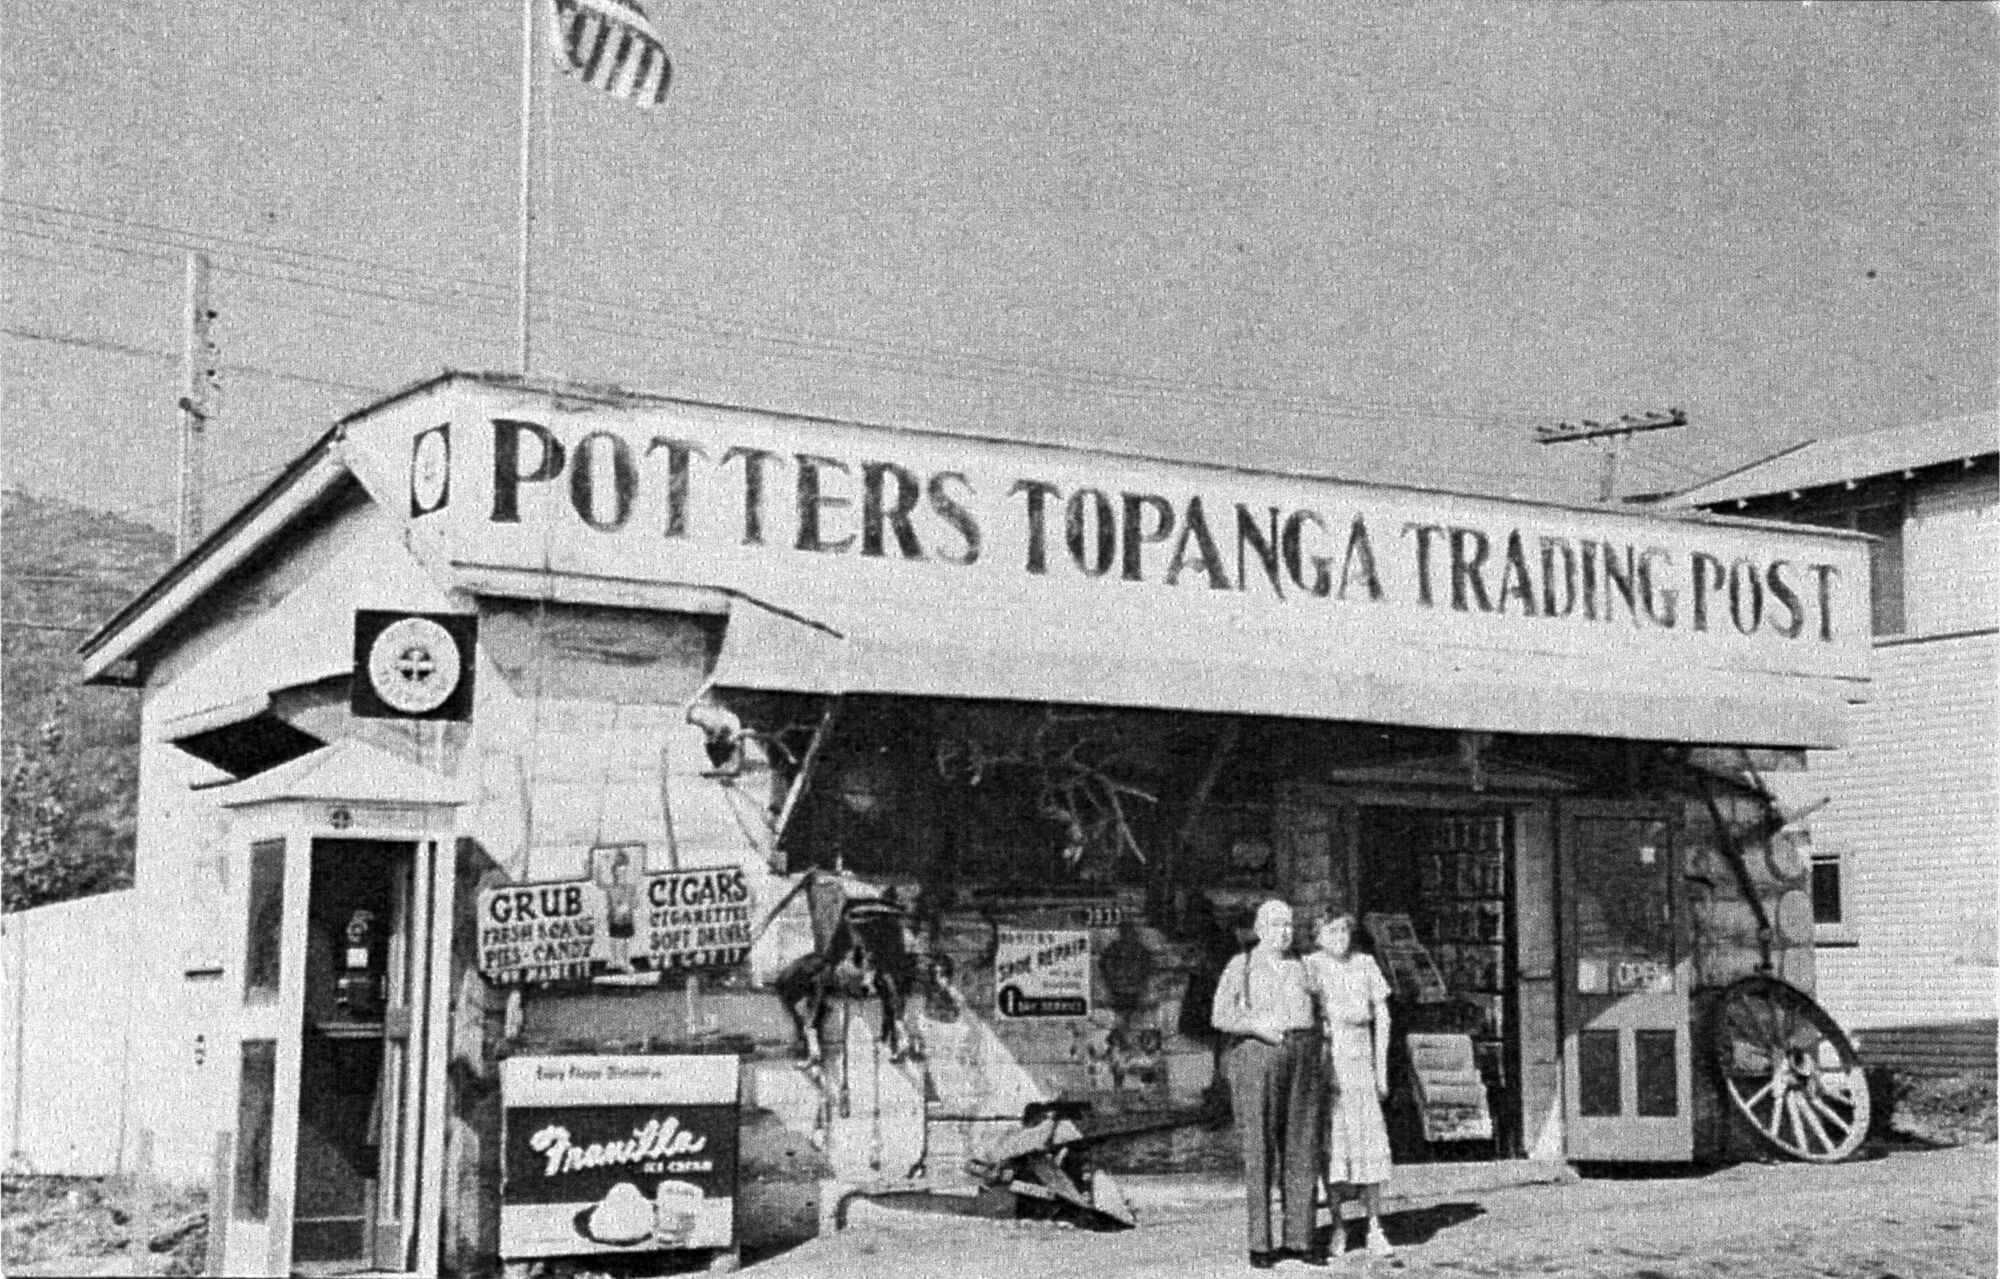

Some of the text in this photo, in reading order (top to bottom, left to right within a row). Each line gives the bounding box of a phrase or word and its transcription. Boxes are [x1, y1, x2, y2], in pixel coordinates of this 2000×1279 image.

[491, 419, 1843, 641] POTTERS TOPANGA TRADING POST
[490, 887, 582, 923] GRUB
[649, 871, 748, 908] CIGARS
[533, 939, 594, 965] CANDY
[651, 922, 752, 950] SOFT DRINKS
[1037, 938, 1087, 967] REPAIR
